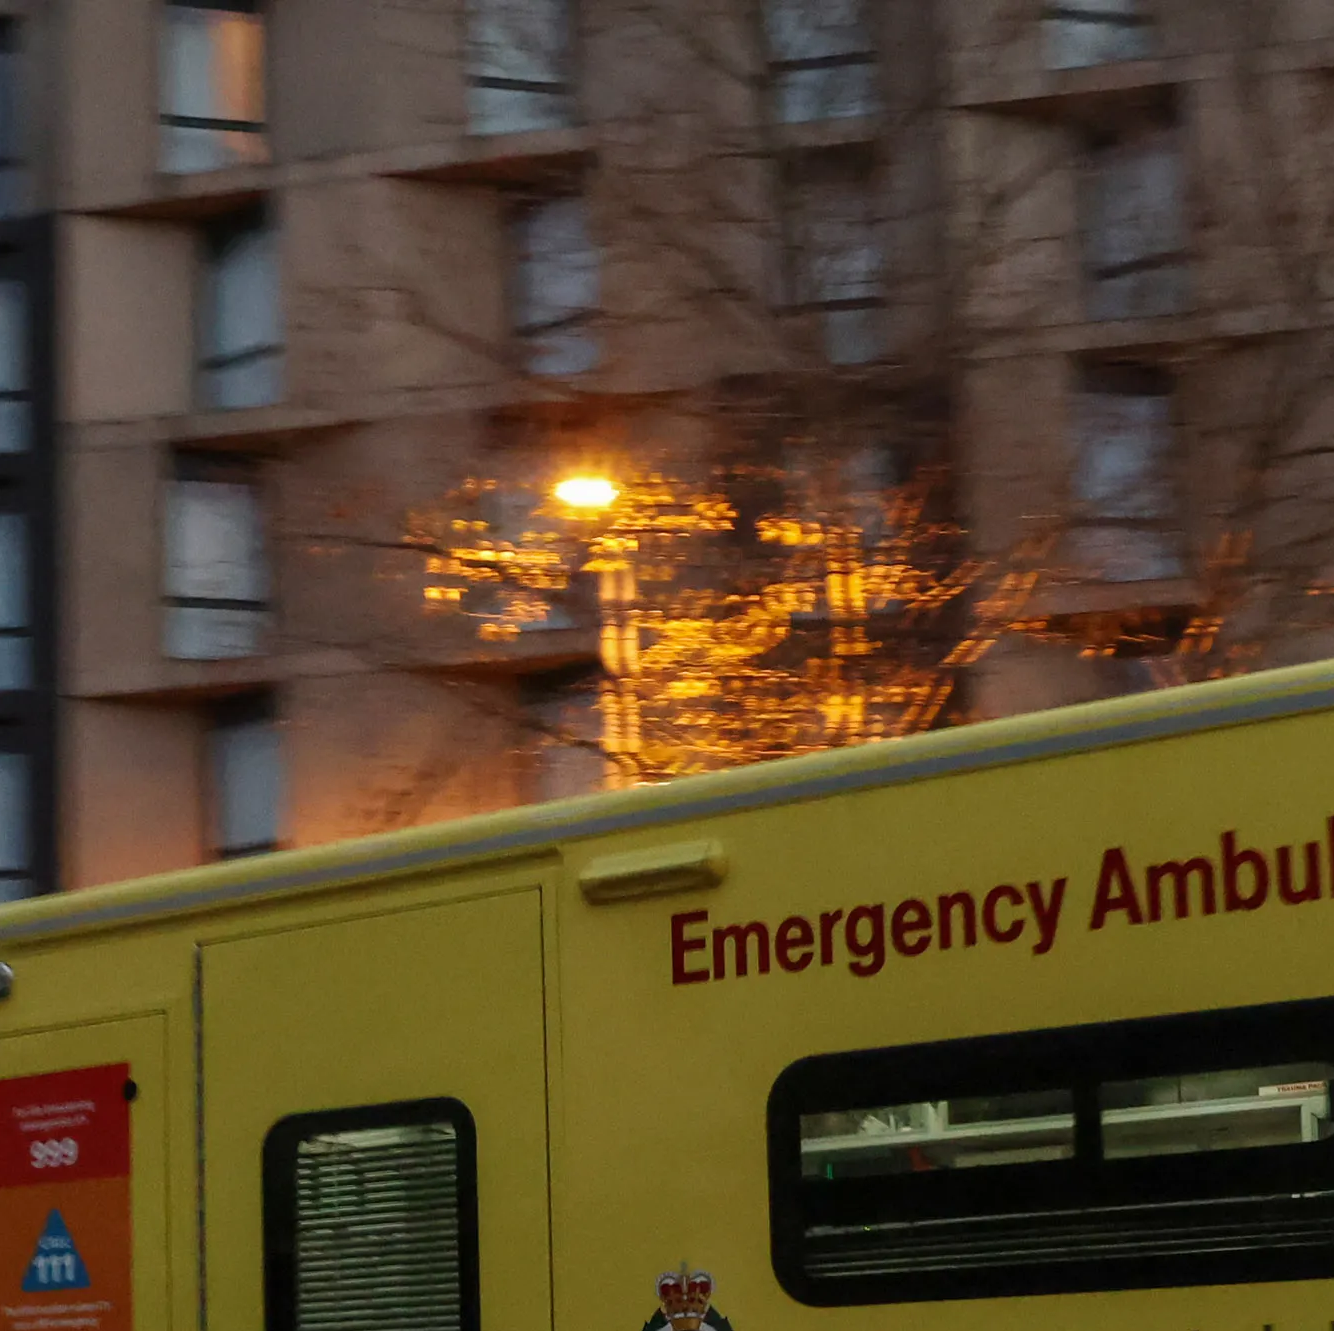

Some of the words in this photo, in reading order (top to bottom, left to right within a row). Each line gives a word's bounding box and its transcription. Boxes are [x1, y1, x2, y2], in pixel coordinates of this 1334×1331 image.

[669, 876, 1068, 985] Emergency
[29, 1136, 79, 1169] 999
[31, 1252, 76, 1284] 111
